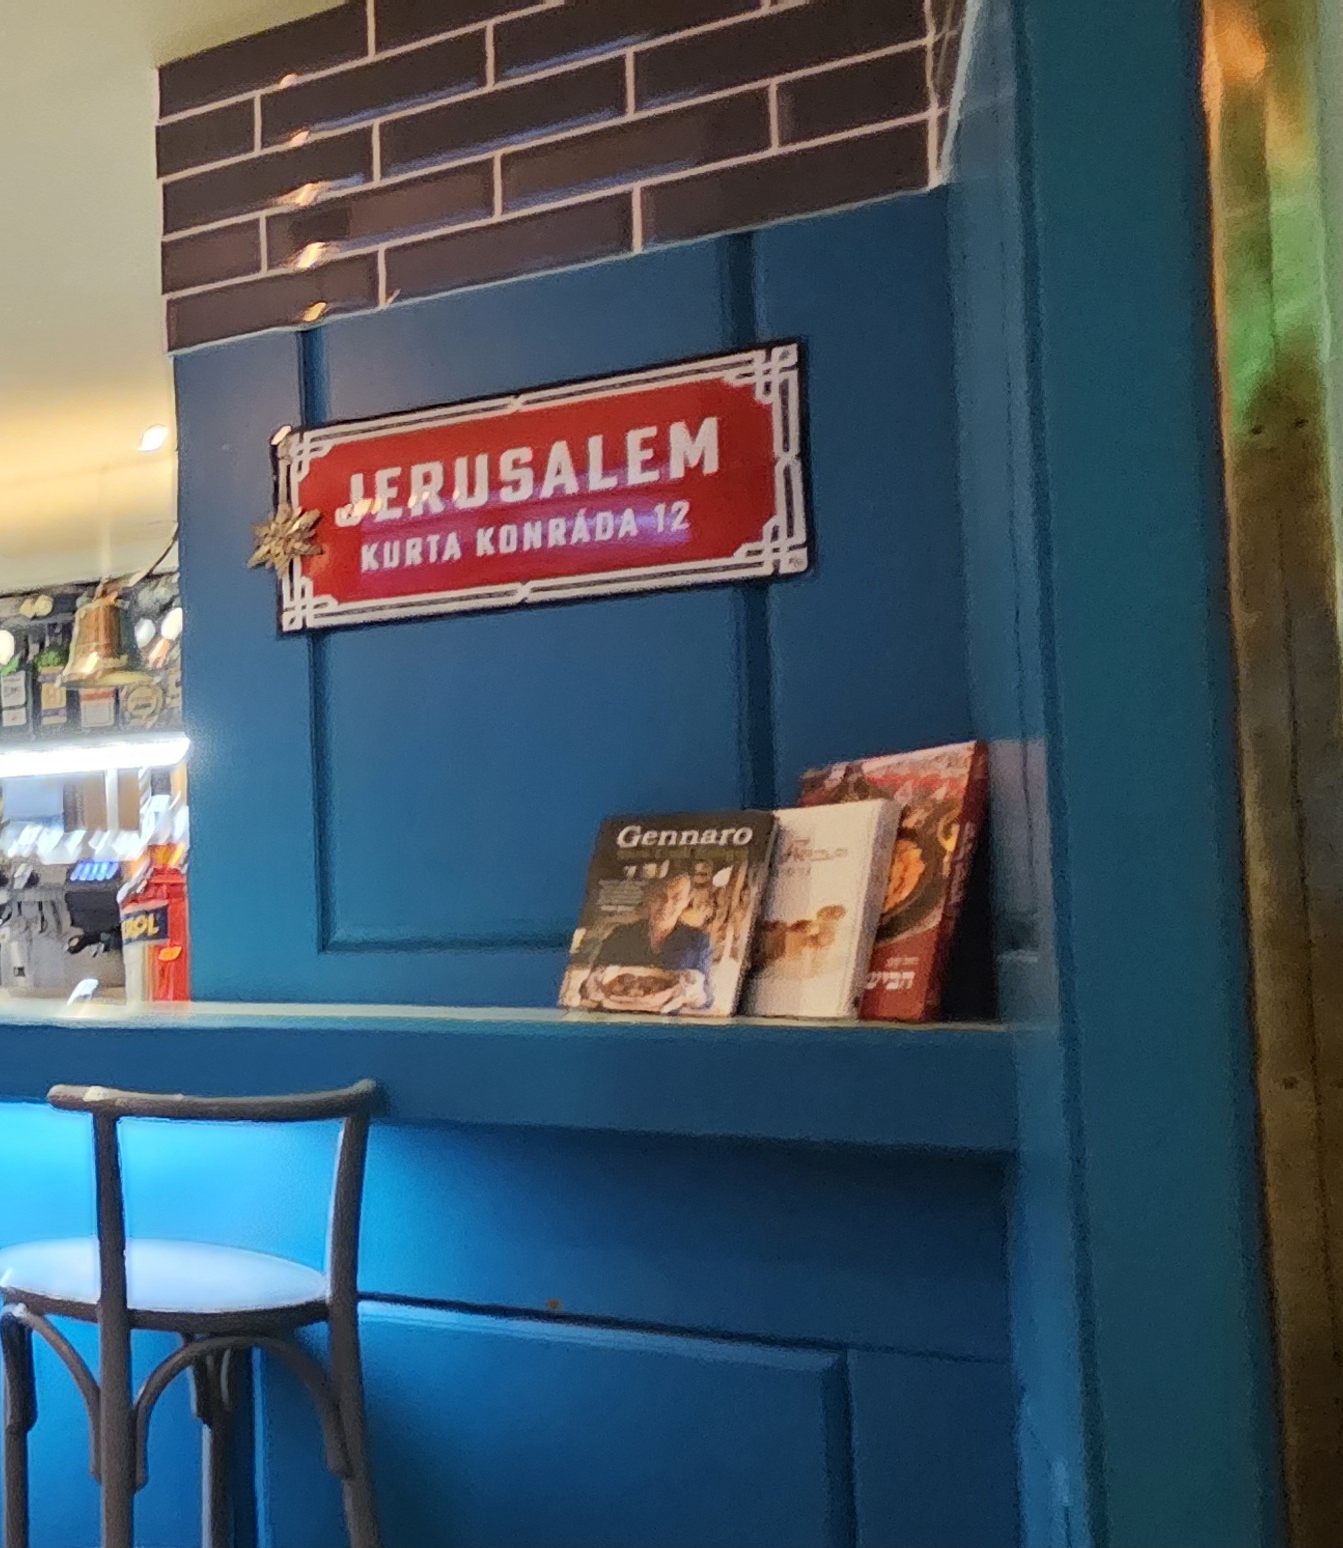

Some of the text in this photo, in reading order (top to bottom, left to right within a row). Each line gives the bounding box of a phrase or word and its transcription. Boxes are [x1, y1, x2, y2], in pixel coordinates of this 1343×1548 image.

[335, 416, 720, 528] JERUSALEM
[360, 500, 691, 573] KURTA KONRÁDA 12
[616, 824, 754, 849] Gennaro
